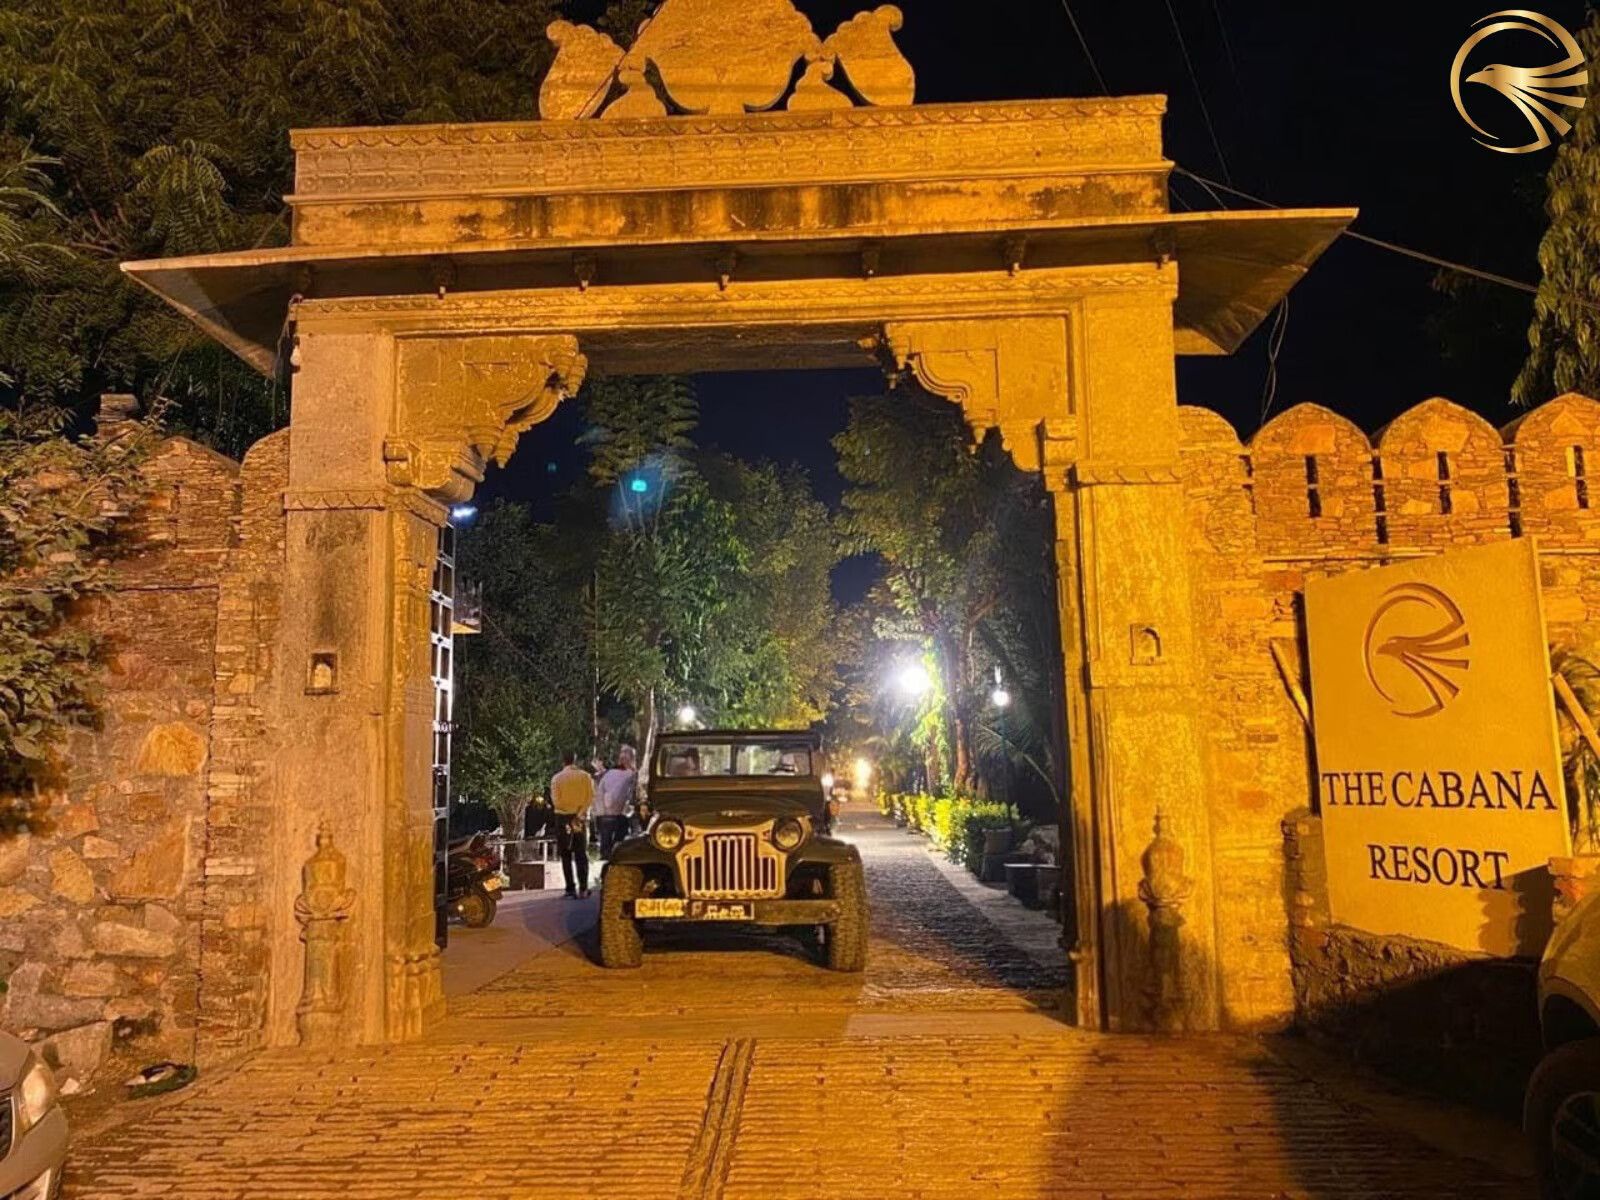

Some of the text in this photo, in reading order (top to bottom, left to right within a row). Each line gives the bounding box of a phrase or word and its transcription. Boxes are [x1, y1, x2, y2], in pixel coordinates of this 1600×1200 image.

[1322, 771, 1557, 810] THE CABANA
[1369, 845, 1508, 890] RESORT
